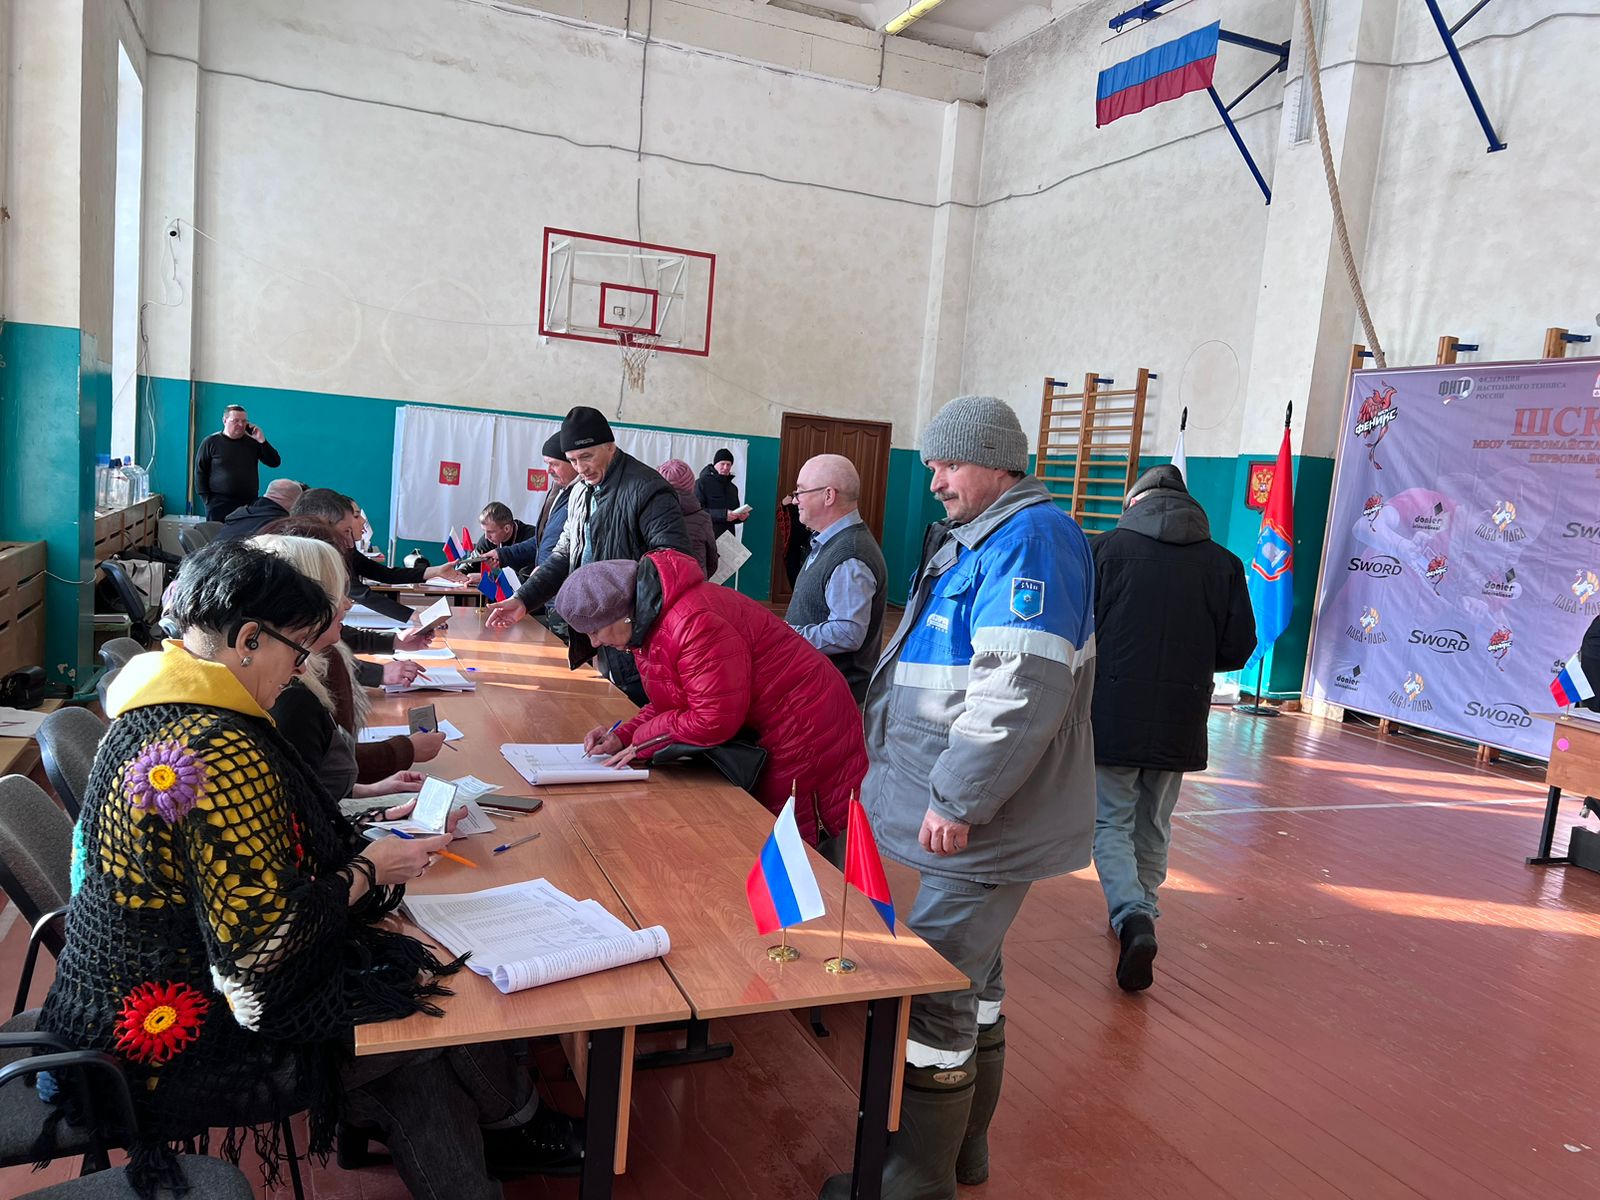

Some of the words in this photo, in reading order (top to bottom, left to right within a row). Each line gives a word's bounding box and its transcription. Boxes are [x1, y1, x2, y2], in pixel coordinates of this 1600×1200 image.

[1355, 409, 1397, 435] ФЕНИКС
[1348, 557, 1402, 576] SWORD
[1484, 580, 1516, 592] donier
[1408, 629, 1470, 652] SWORD
[1464, 701, 1533, 728] SWORD
